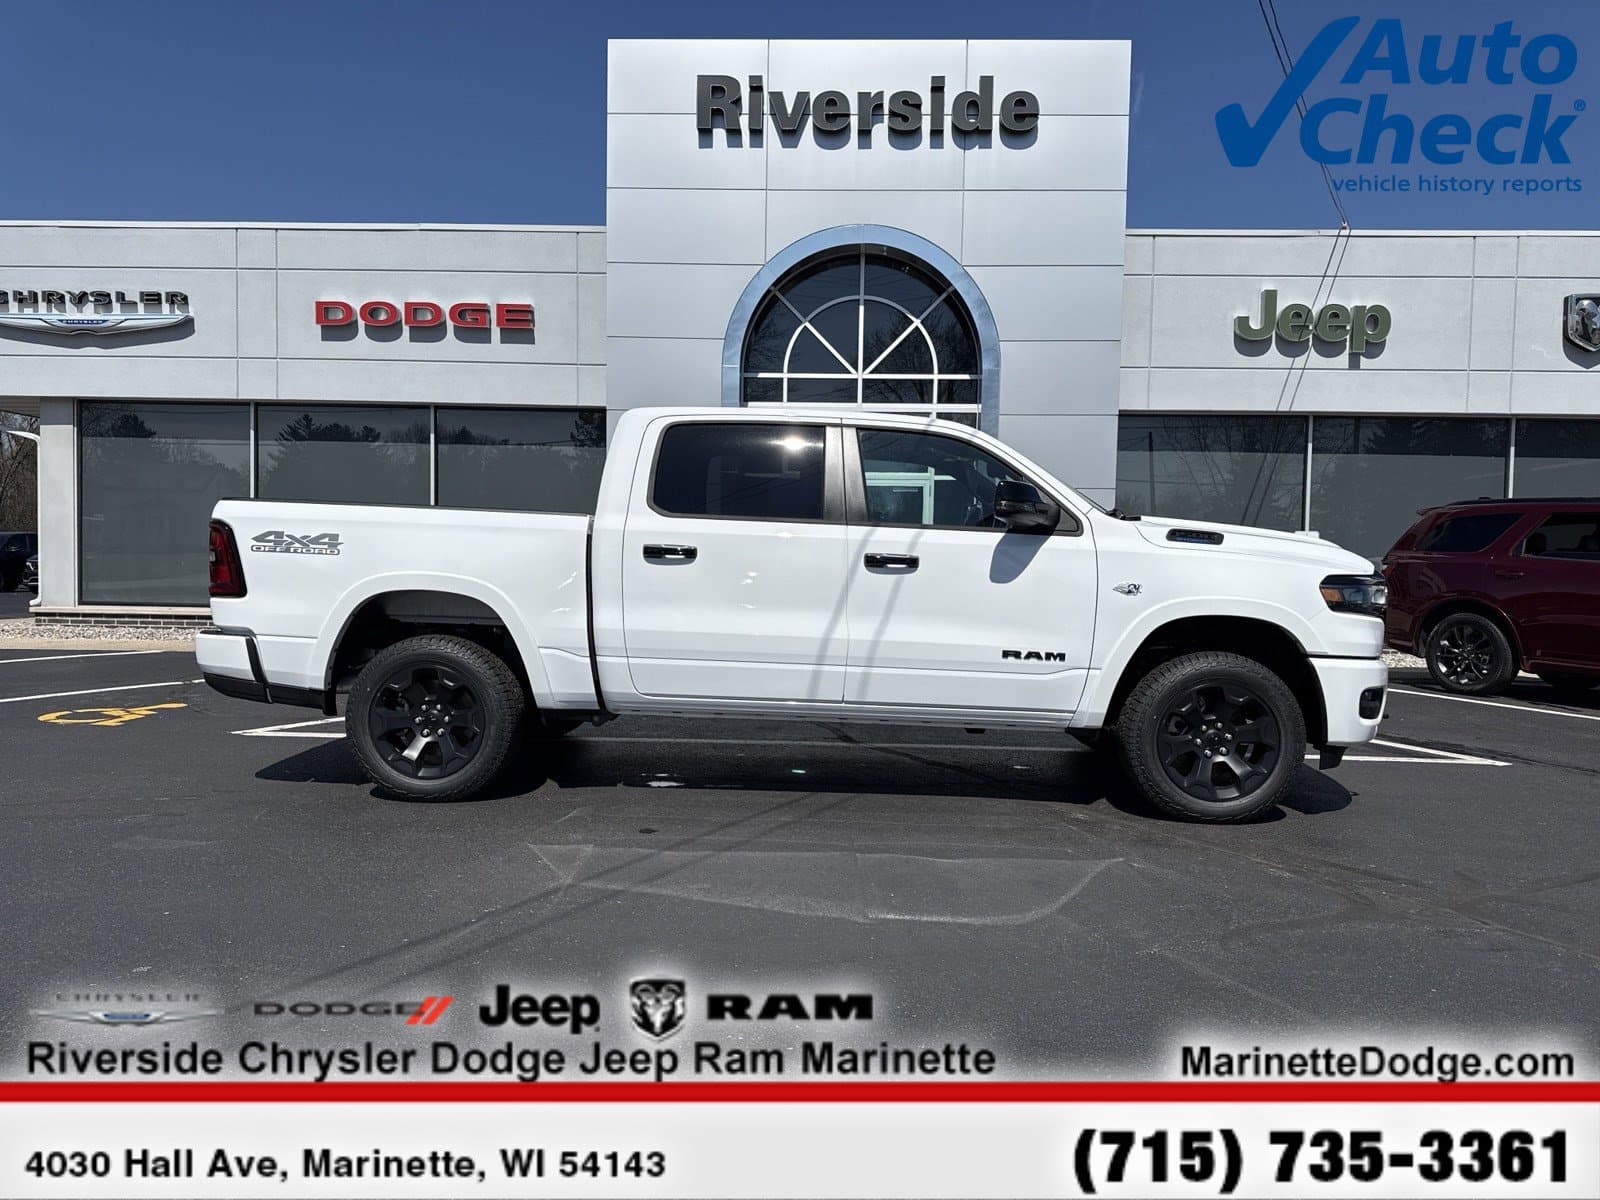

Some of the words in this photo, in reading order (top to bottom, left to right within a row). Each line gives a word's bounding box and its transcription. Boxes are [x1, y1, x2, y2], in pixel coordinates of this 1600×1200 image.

[696, 74, 1040, 132] Riverside
[315, 300, 535, 329] DODGE
[1233, 289, 1392, 353] Jeep
[251, 530, 344, 549] 4x4
[1001, 649, 1066, 662] RAM
